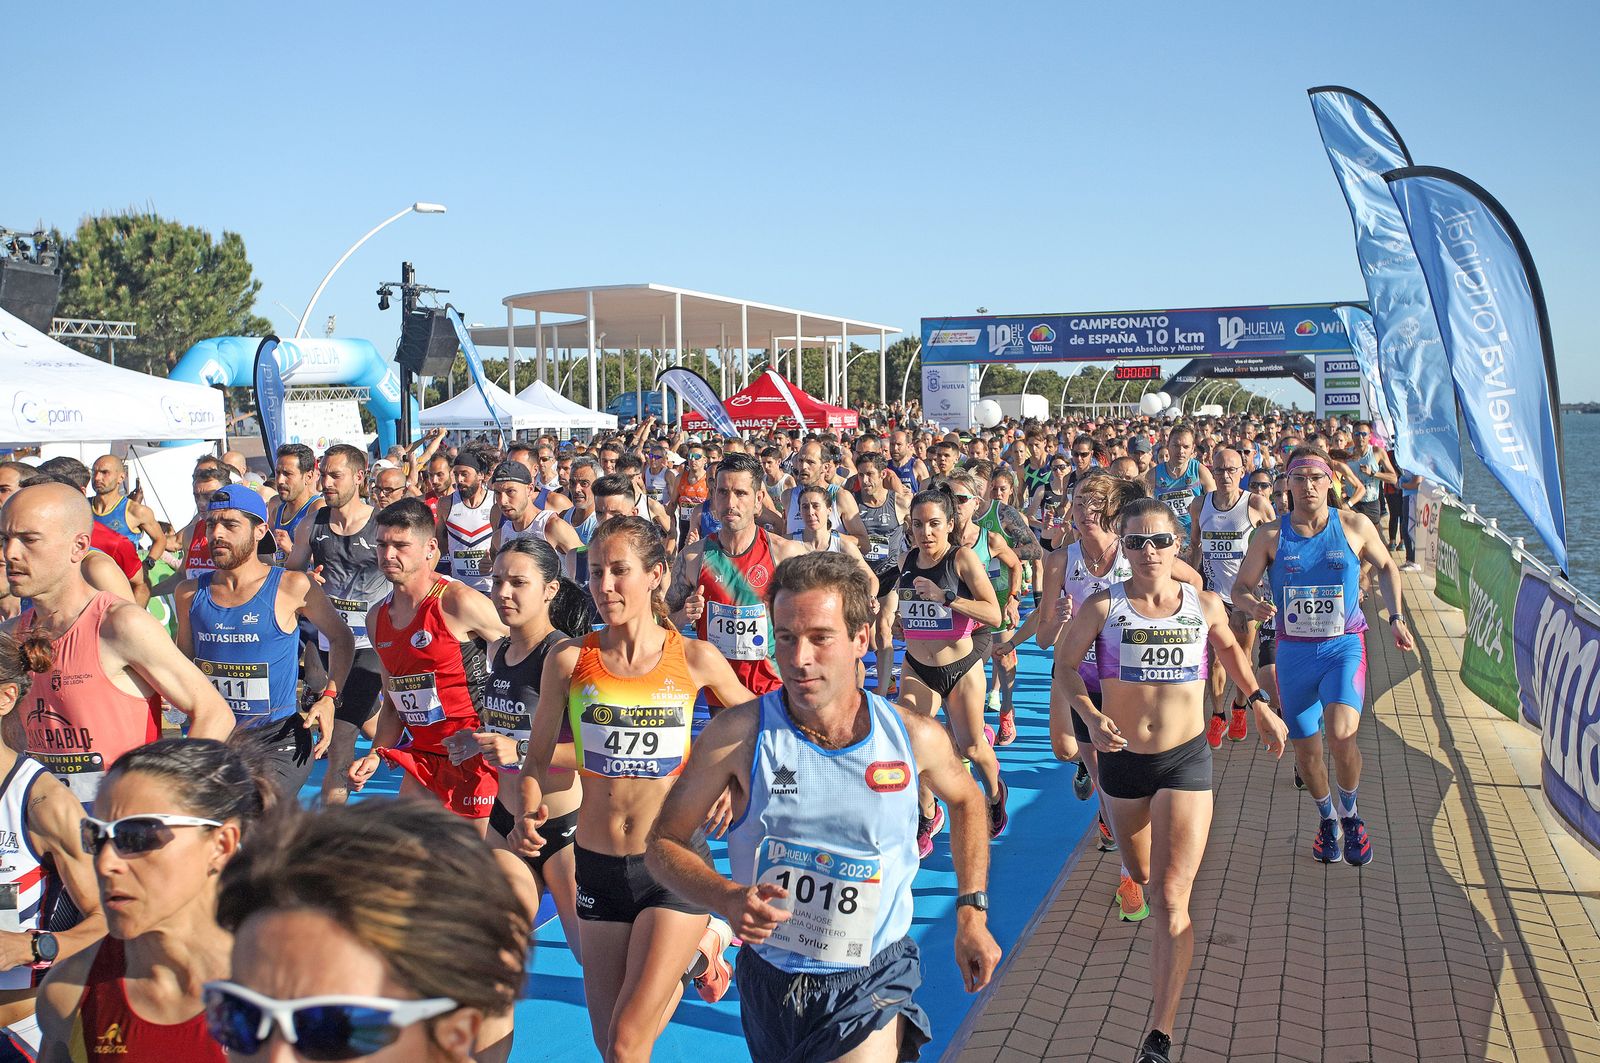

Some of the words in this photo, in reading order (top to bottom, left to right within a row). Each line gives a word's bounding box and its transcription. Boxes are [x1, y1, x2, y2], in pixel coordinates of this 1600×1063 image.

[1070, 316, 1169, 330] CAMPEONATO
[1244, 321, 1285, 335] HUELVA
[1070, 335, 1085, 345] de
[1088, 330, 1138, 344] ESPAÑA
[1146, 329, 1169, 344] 10
[1174, 328, 1205, 344] km
[1135, 345, 1169, 353] Absoluto
[1210, 541, 1232, 551] 360
[908, 603, 936, 618] 416
[1294, 600, 1334, 614] 1629
[716, 619, 757, 635] 1894
[1141, 647, 1184, 666] 490
[395, 675, 426, 685] RUNNING
[401, 693, 418, 711] 62
[651, 693, 690, 701] SERRANO
[487, 696, 525, 715] BARCO
[620, 709, 674, 717] RUNNING
[498, 720, 516, 728] LOOP
[604, 731, 659, 755] 479
[785, 849, 812, 864] HUELVA
[839, 862, 873, 878] 2023
[776, 870, 859, 914] 1018
[791, 908, 811, 919] JUAN
[812, 915, 832, 926] JOSE
[784, 917, 804, 926] RCIA
[805, 922, 846, 937] QUINTERO
